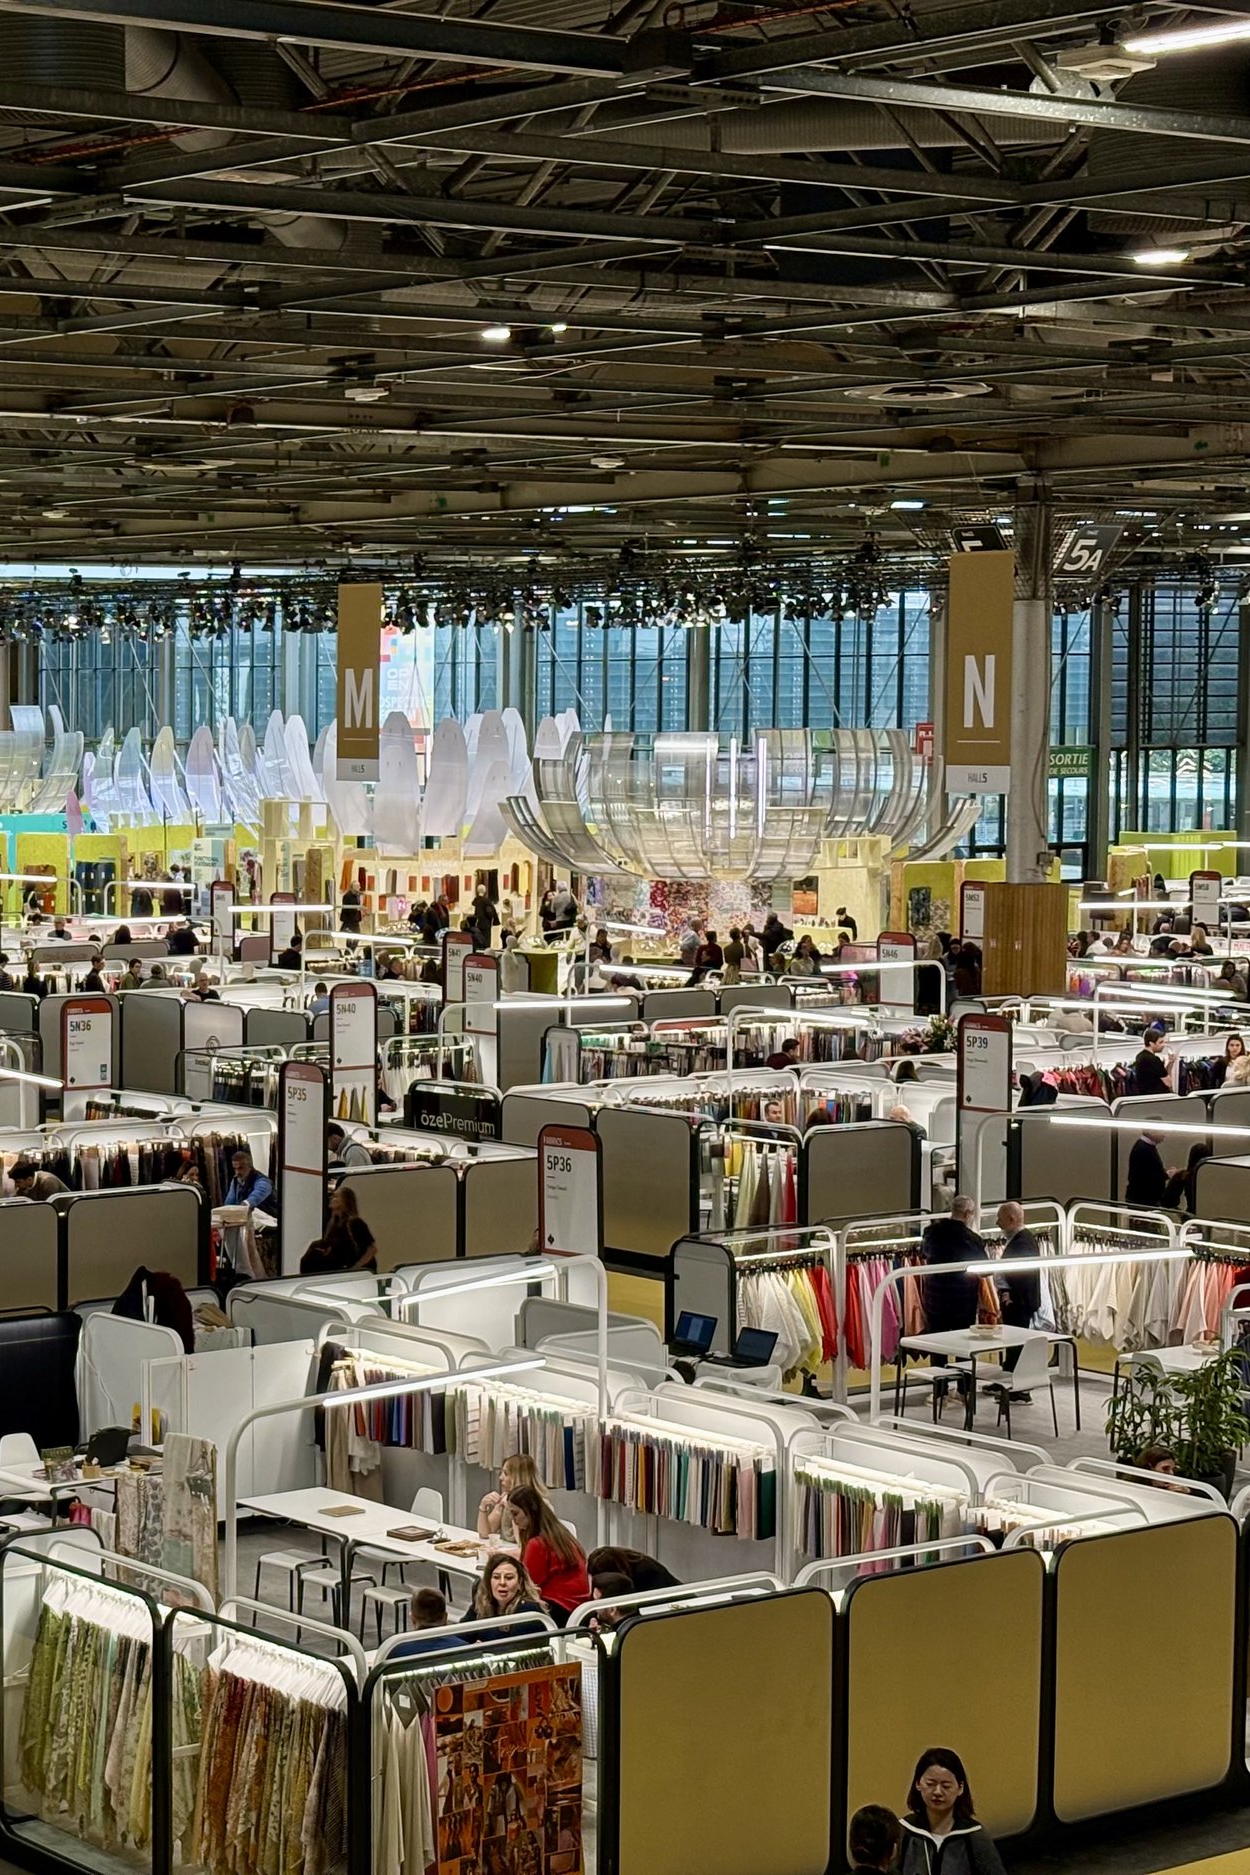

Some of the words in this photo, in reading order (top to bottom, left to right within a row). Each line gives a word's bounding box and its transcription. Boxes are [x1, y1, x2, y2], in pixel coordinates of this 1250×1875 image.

[1063, 539, 1103, 571] 5A
[344, 668, 373, 728] M
[963, 655, 995, 728] N
[1049, 753, 1089, 766] SORTIE
[1060, 766, 1088, 775] SECOURS
[336, 1003, 356, 1015] 5N40
[69, 1020, 92, 1032] 5N36
[966, 1035, 989, 1049] 5P39
[287, 1086, 307, 1102] 5P35
[546, 1155, 572, 1173] 5P36
